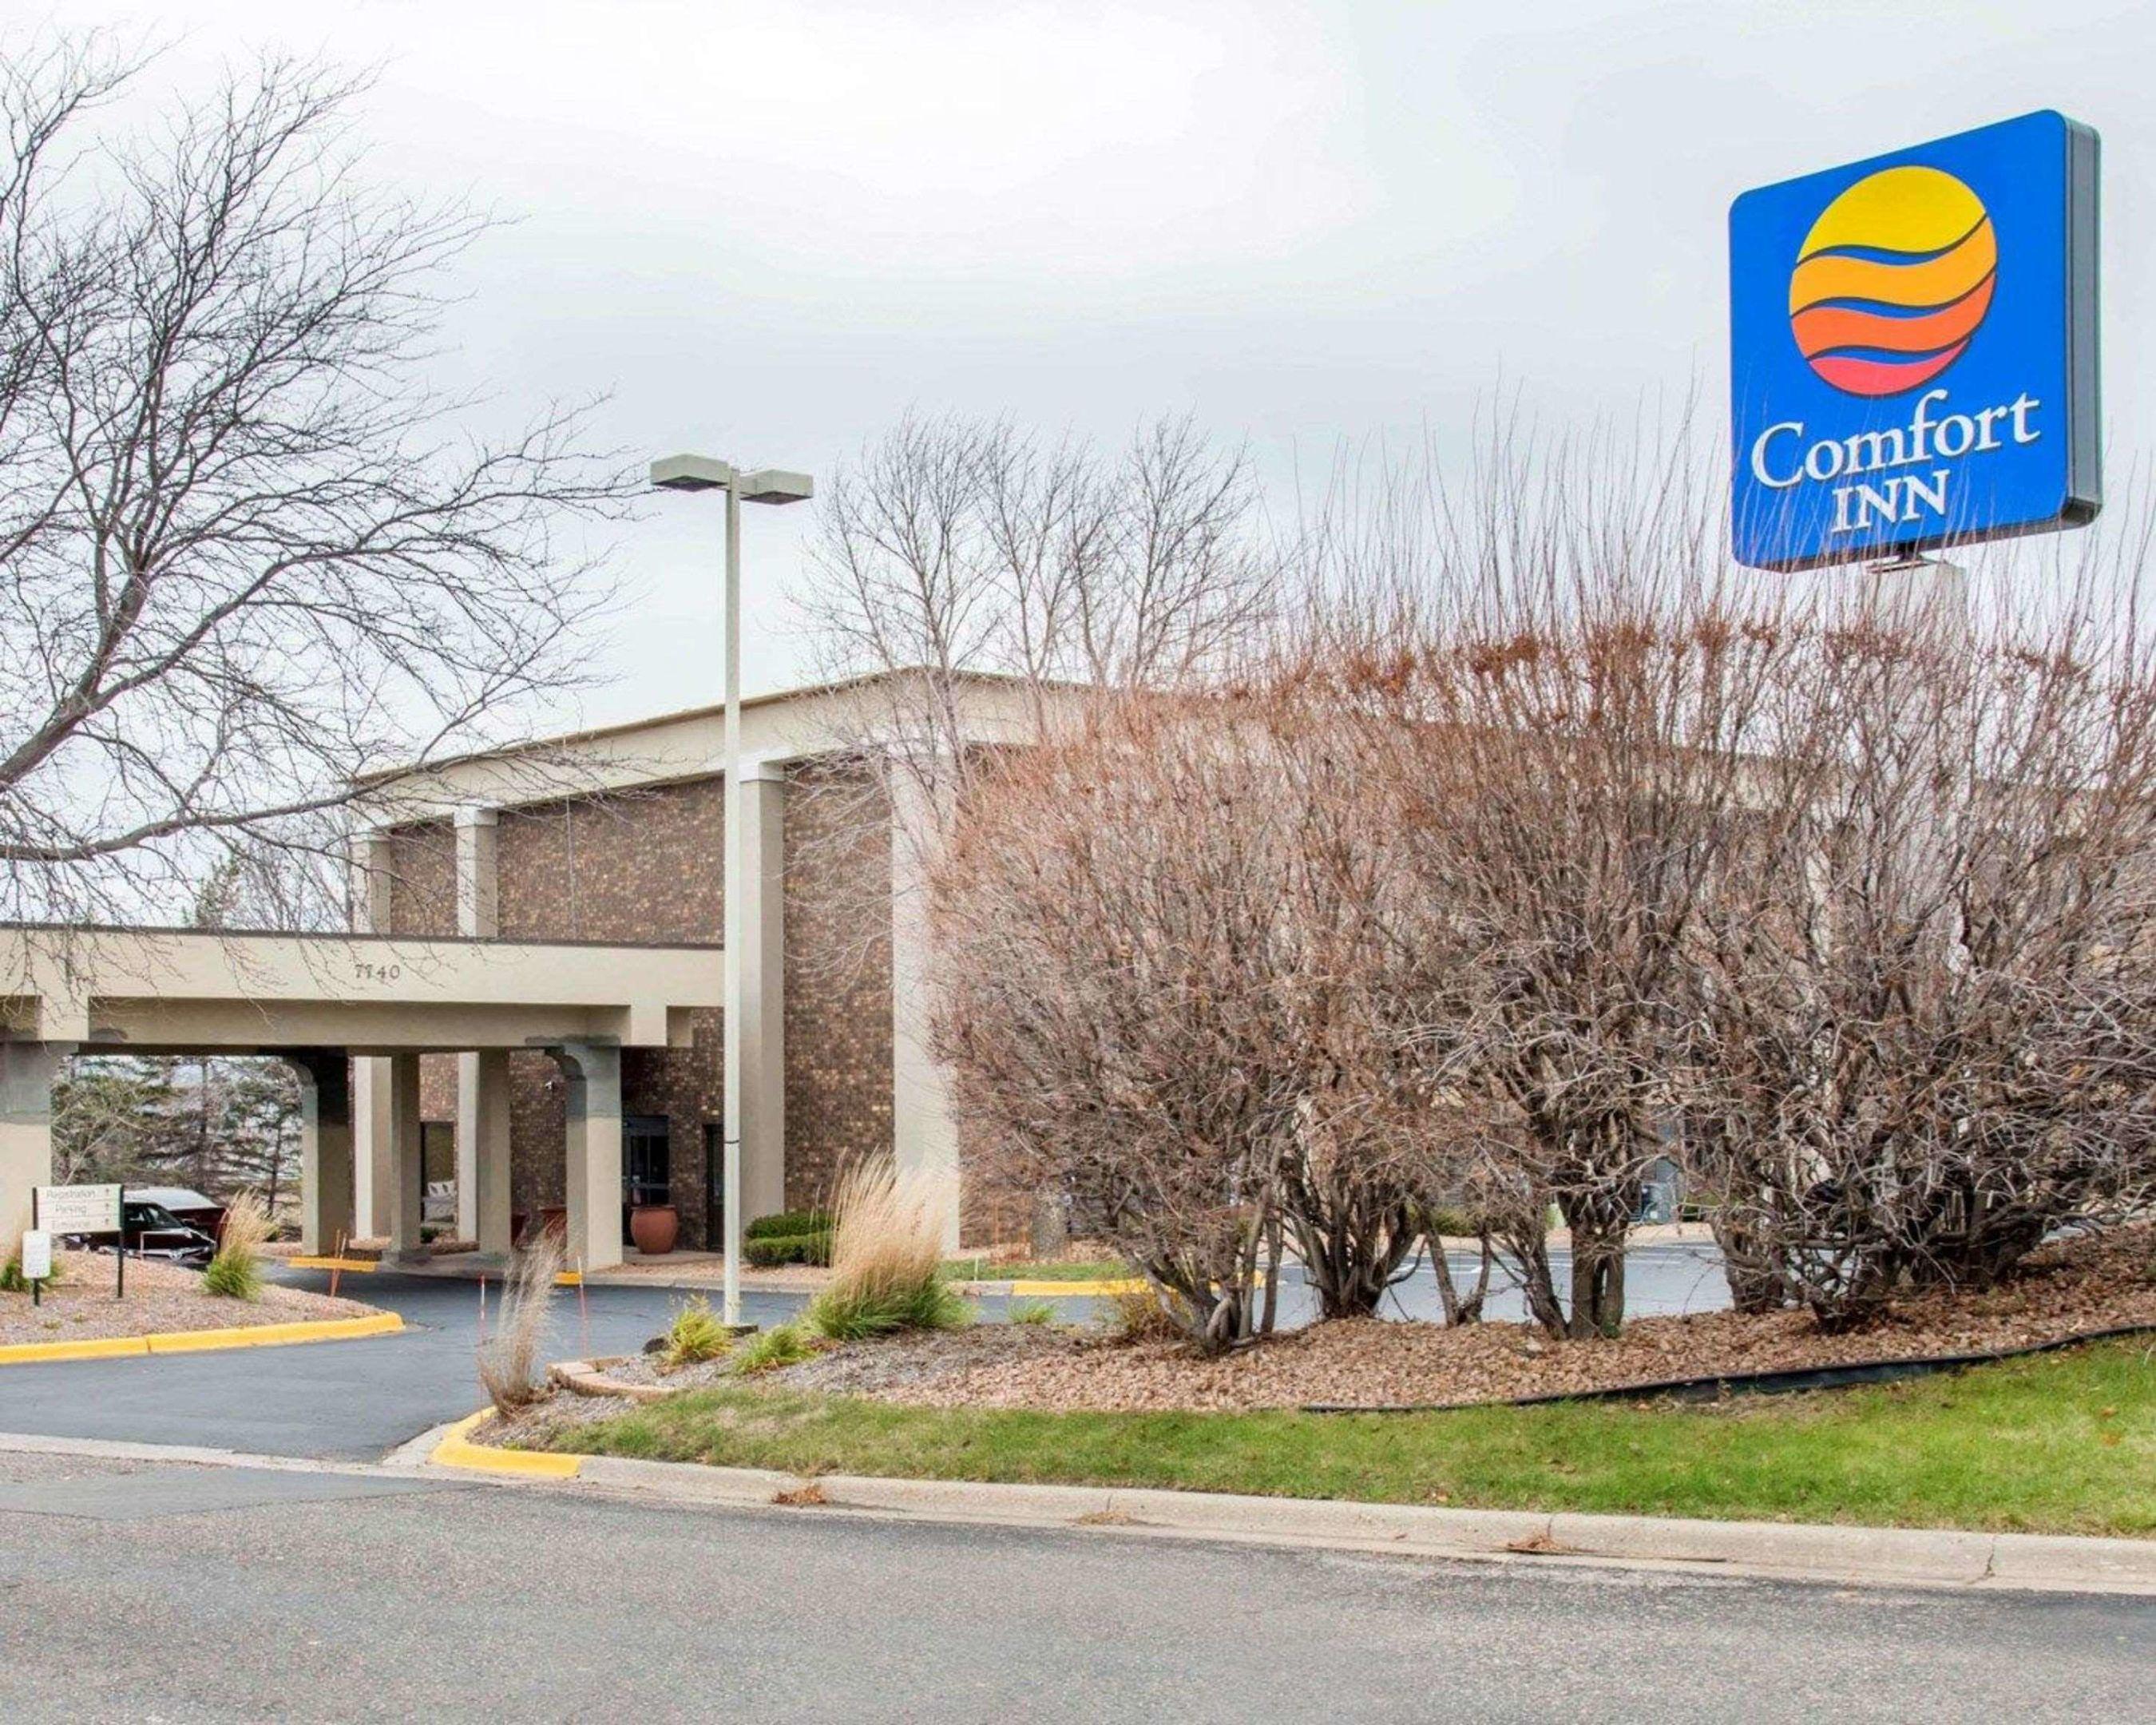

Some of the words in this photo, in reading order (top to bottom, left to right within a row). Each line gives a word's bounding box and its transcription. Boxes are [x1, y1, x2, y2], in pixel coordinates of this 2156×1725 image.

[1751, 389, 2040, 488] Comfort
[1831, 469, 1950, 533] INN
[355, 964, 400, 979] 7740
